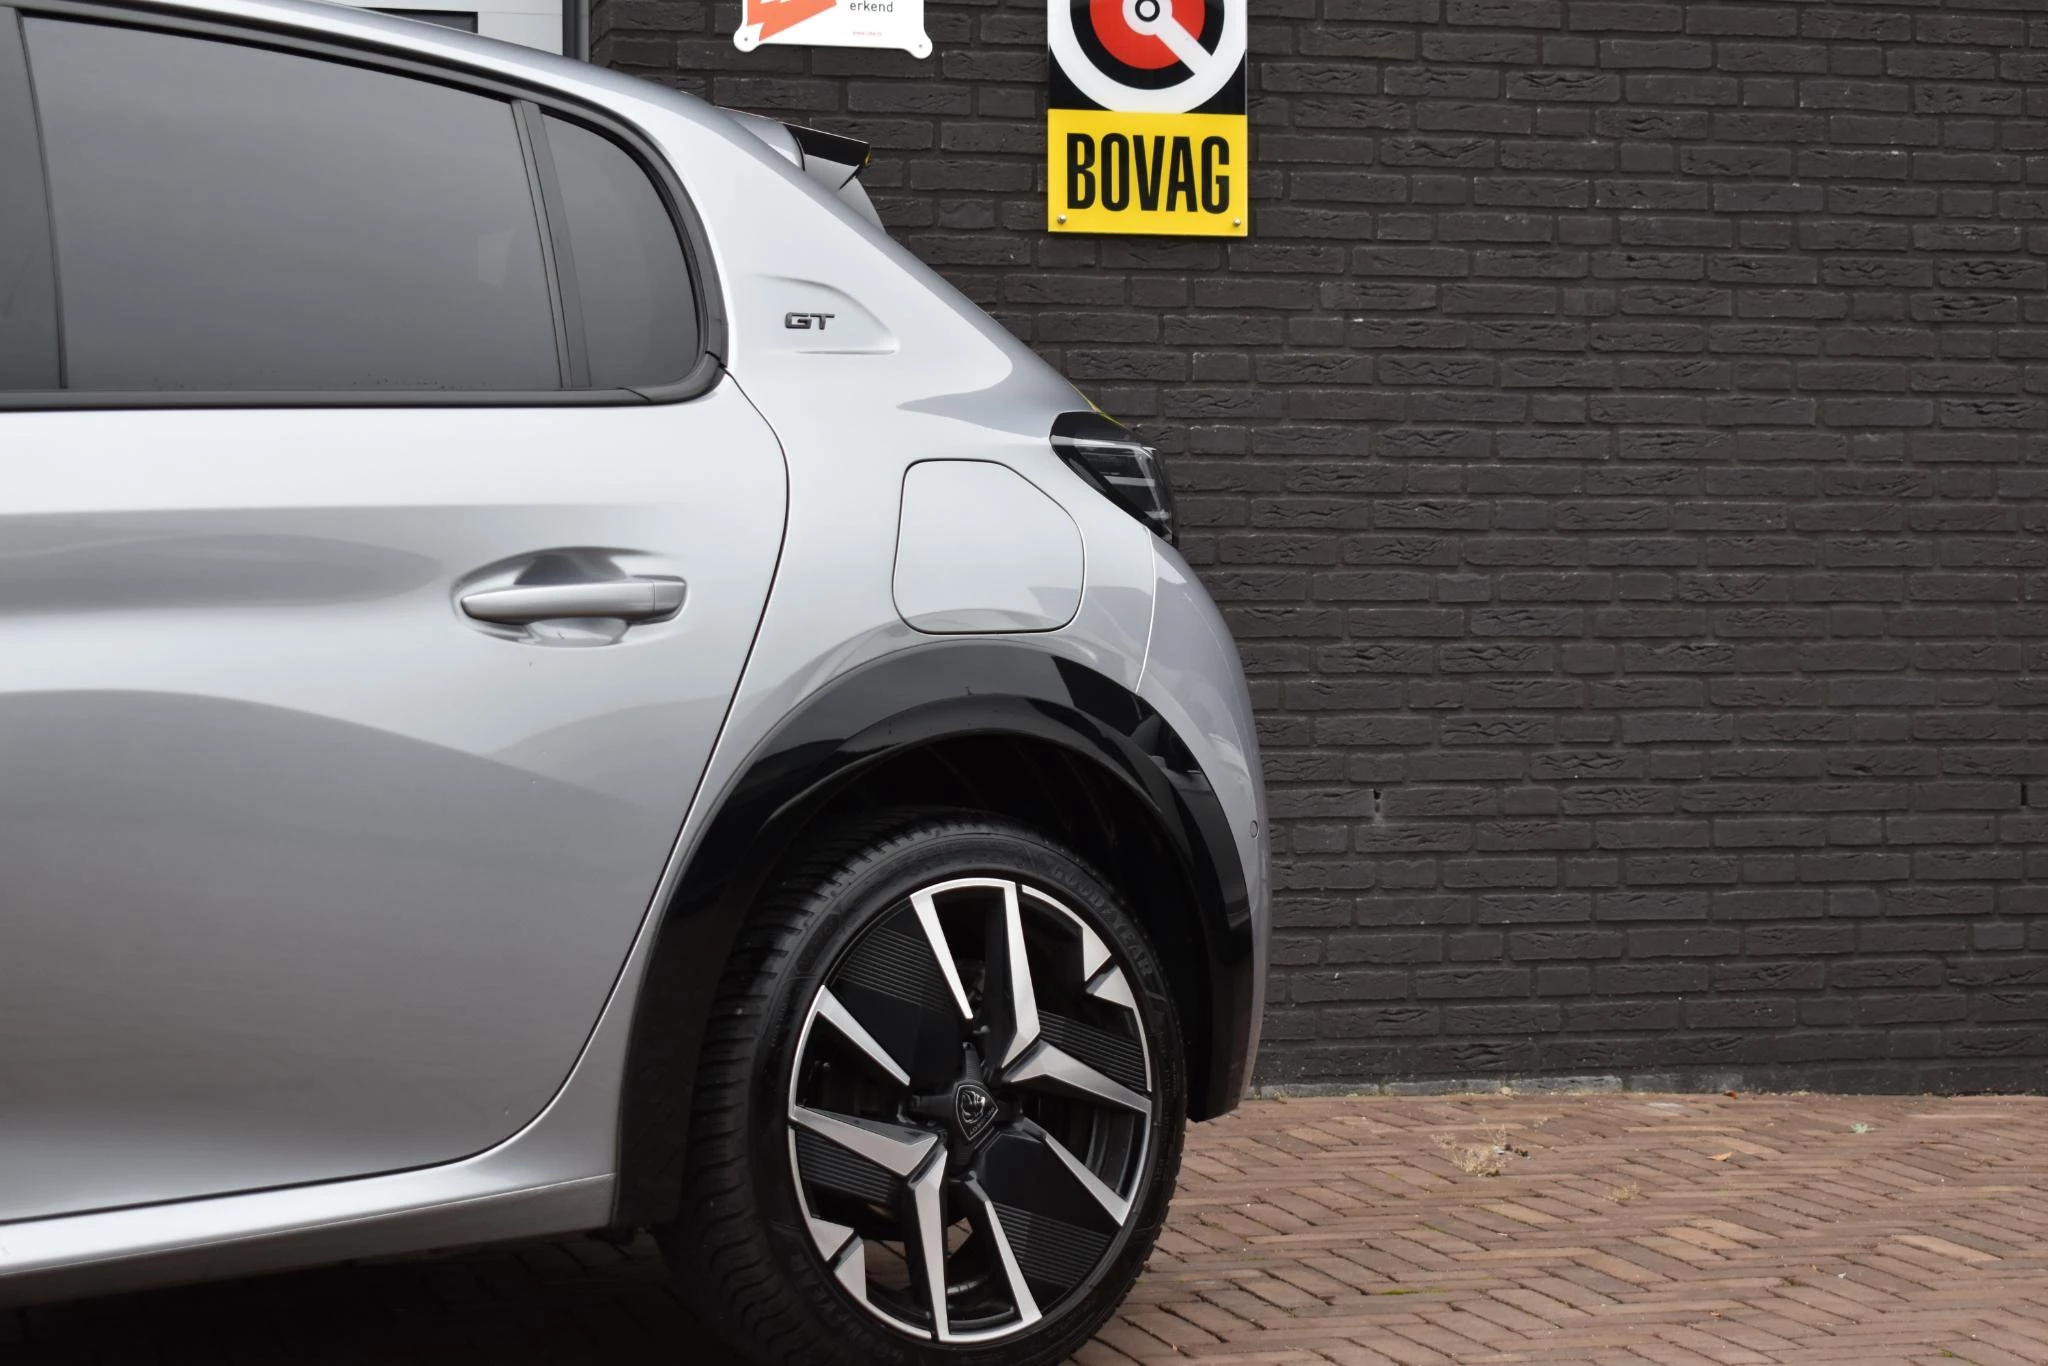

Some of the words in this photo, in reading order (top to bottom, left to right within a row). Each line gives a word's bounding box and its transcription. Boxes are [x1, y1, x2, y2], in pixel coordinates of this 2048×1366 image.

[850, 1, 894, 13] erkend
[1066, 132, 1230, 214] BOVAG
[785, 312, 835, 330] GT
